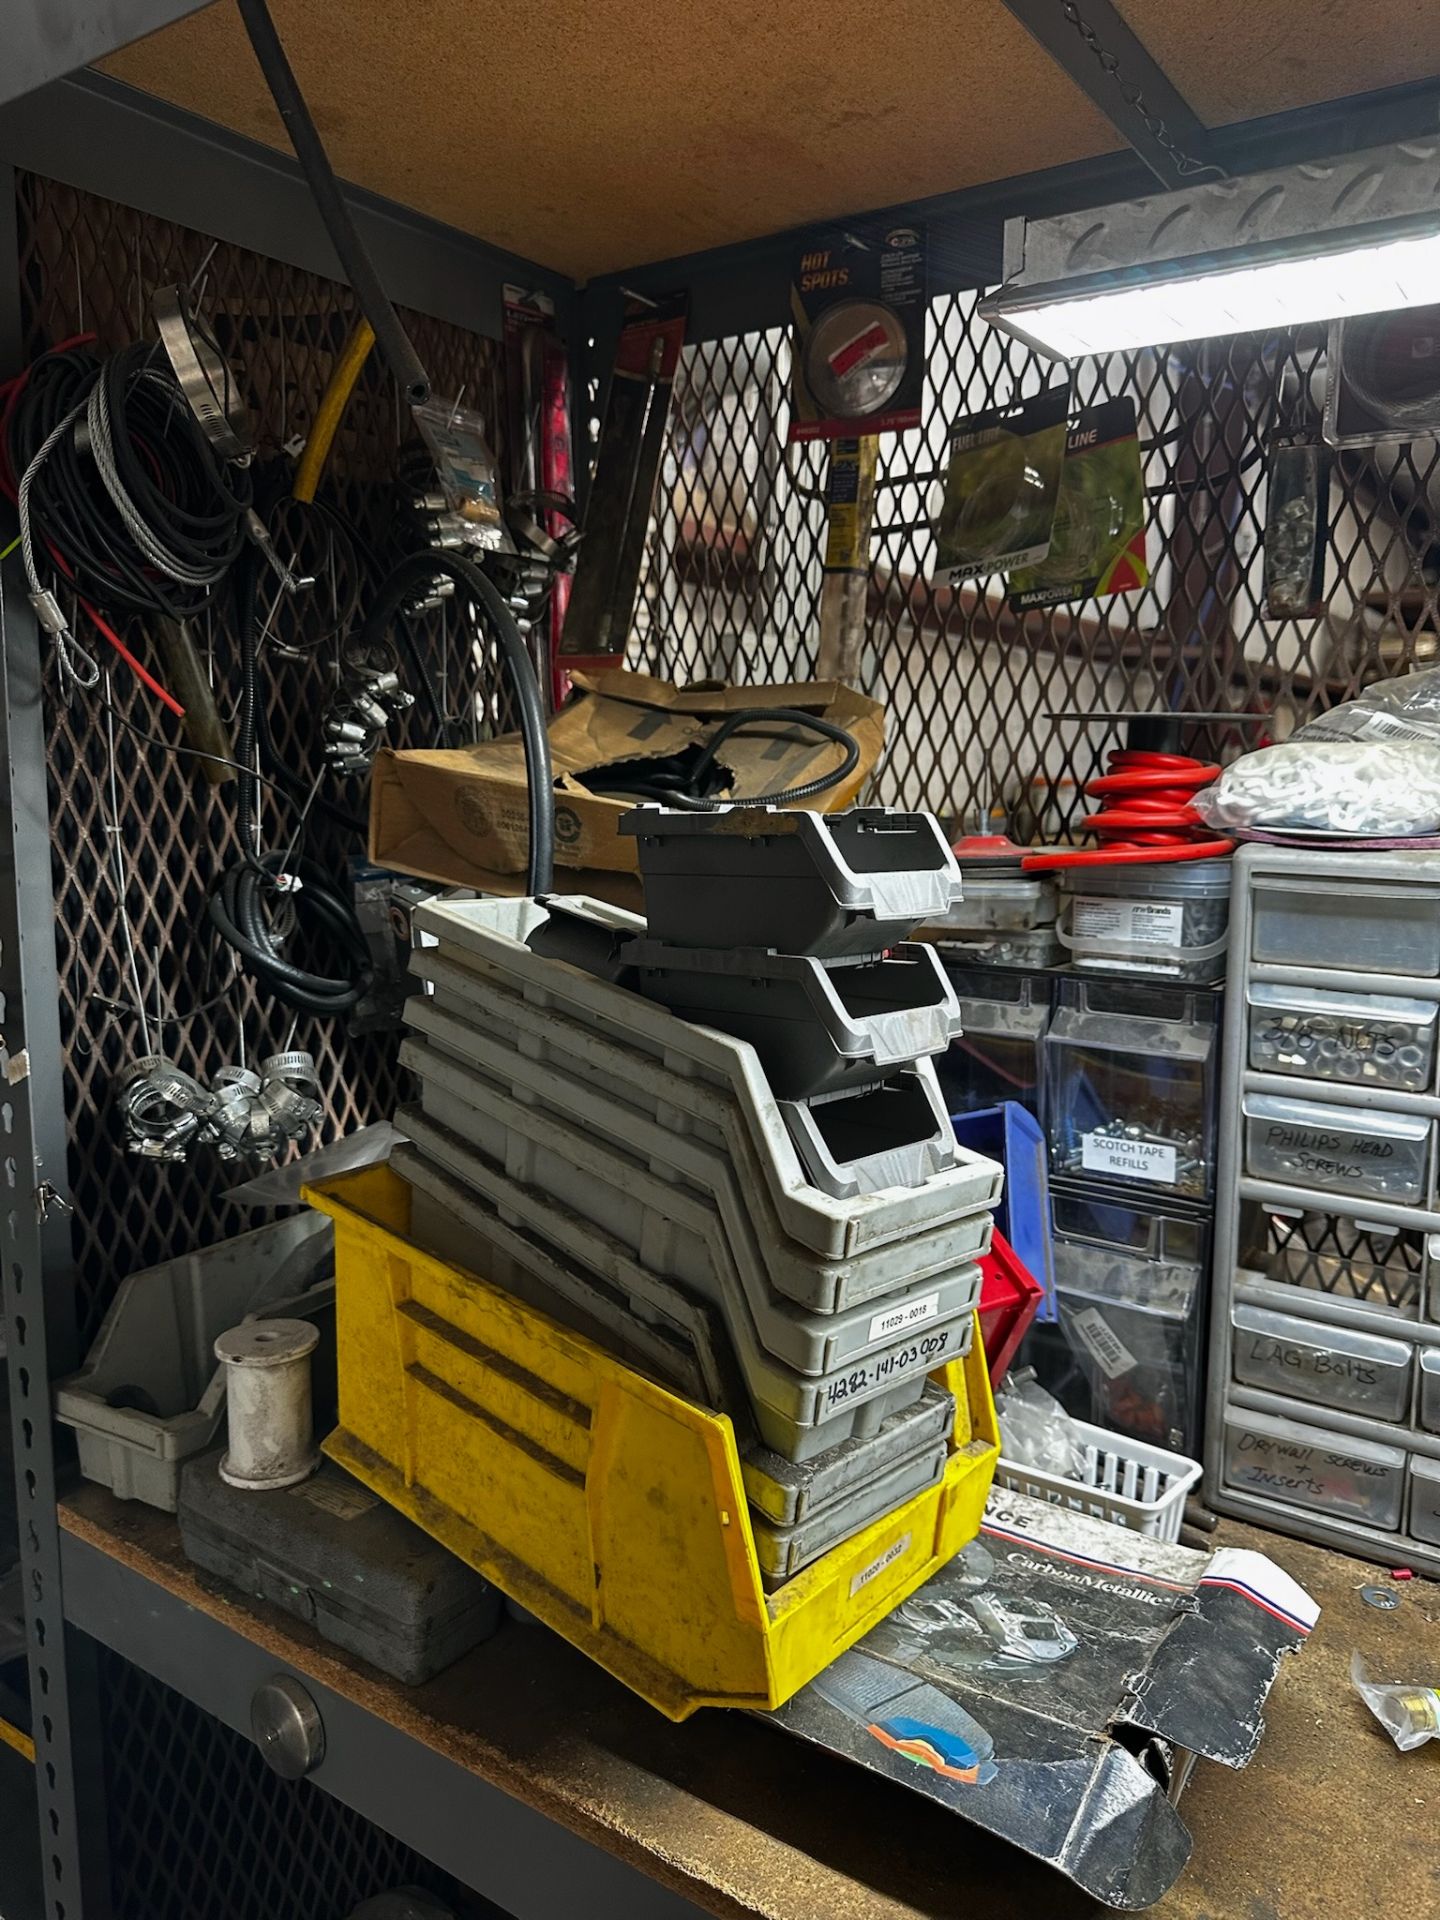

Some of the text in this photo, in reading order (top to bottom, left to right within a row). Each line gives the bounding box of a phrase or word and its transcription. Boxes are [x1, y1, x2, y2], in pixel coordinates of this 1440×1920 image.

[800, 249, 832, 271] HOT
[800, 267, 849, 292] SPOTS
[952, 433, 976, 453] FUEL
[1067, 428, 1098, 450] LINE
[1263, 1016, 1313, 1049] 3/8
[1093, 1137, 1165, 1158] SCOTCH TAPE
[1265, 1125, 1394, 1158] PHILIPS HEAD
[1109, 1155, 1149, 1171] REFILLS
[1290, 1151, 1364, 1179] SCREWS
[1250, 1340, 1377, 1385] LAG Bolts
